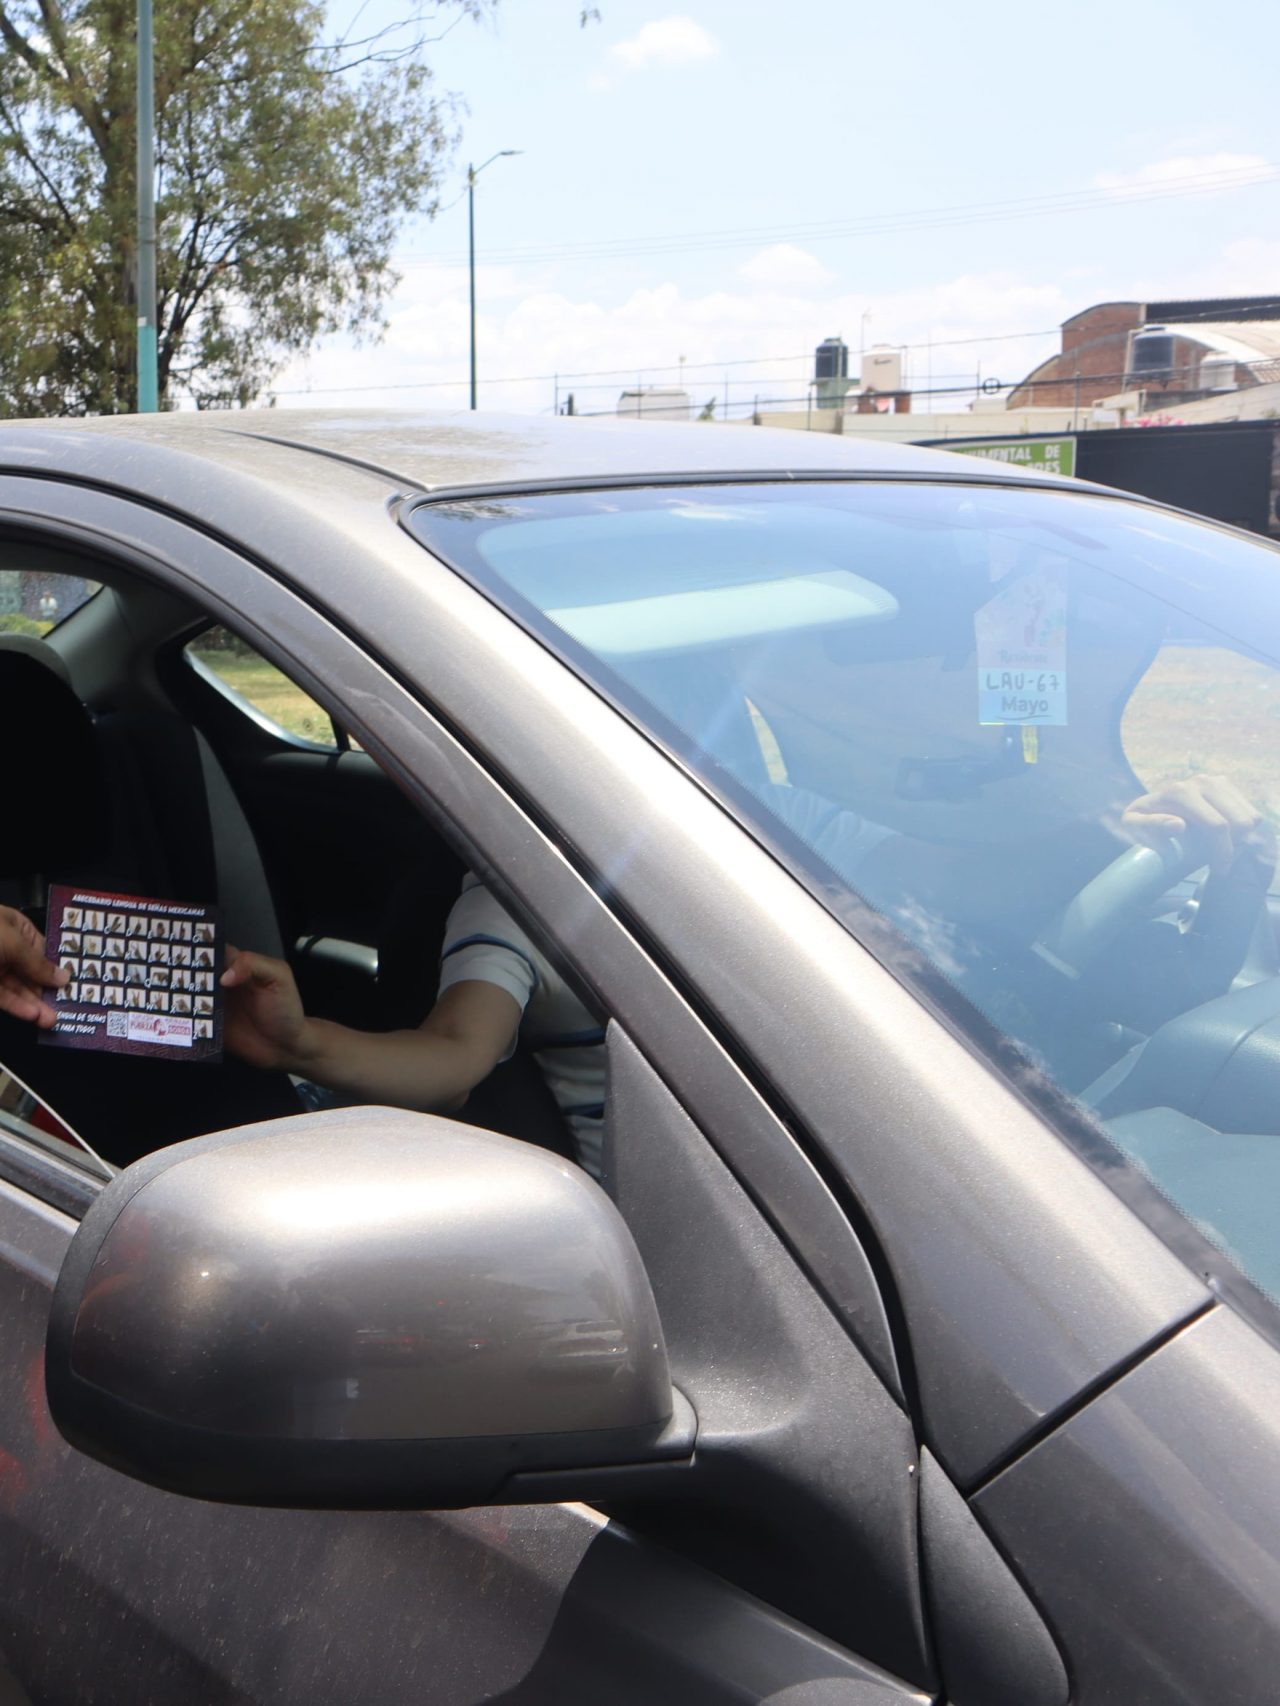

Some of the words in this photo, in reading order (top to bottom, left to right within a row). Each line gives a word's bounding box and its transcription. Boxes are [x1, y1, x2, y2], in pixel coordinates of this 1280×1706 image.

[1045, 445, 1061, 458] DE
[986, 672, 1060, 692] LAU-67
[1001, 696, 1049, 715] Mayo
[55, 1010, 77, 1020] ENGUA
